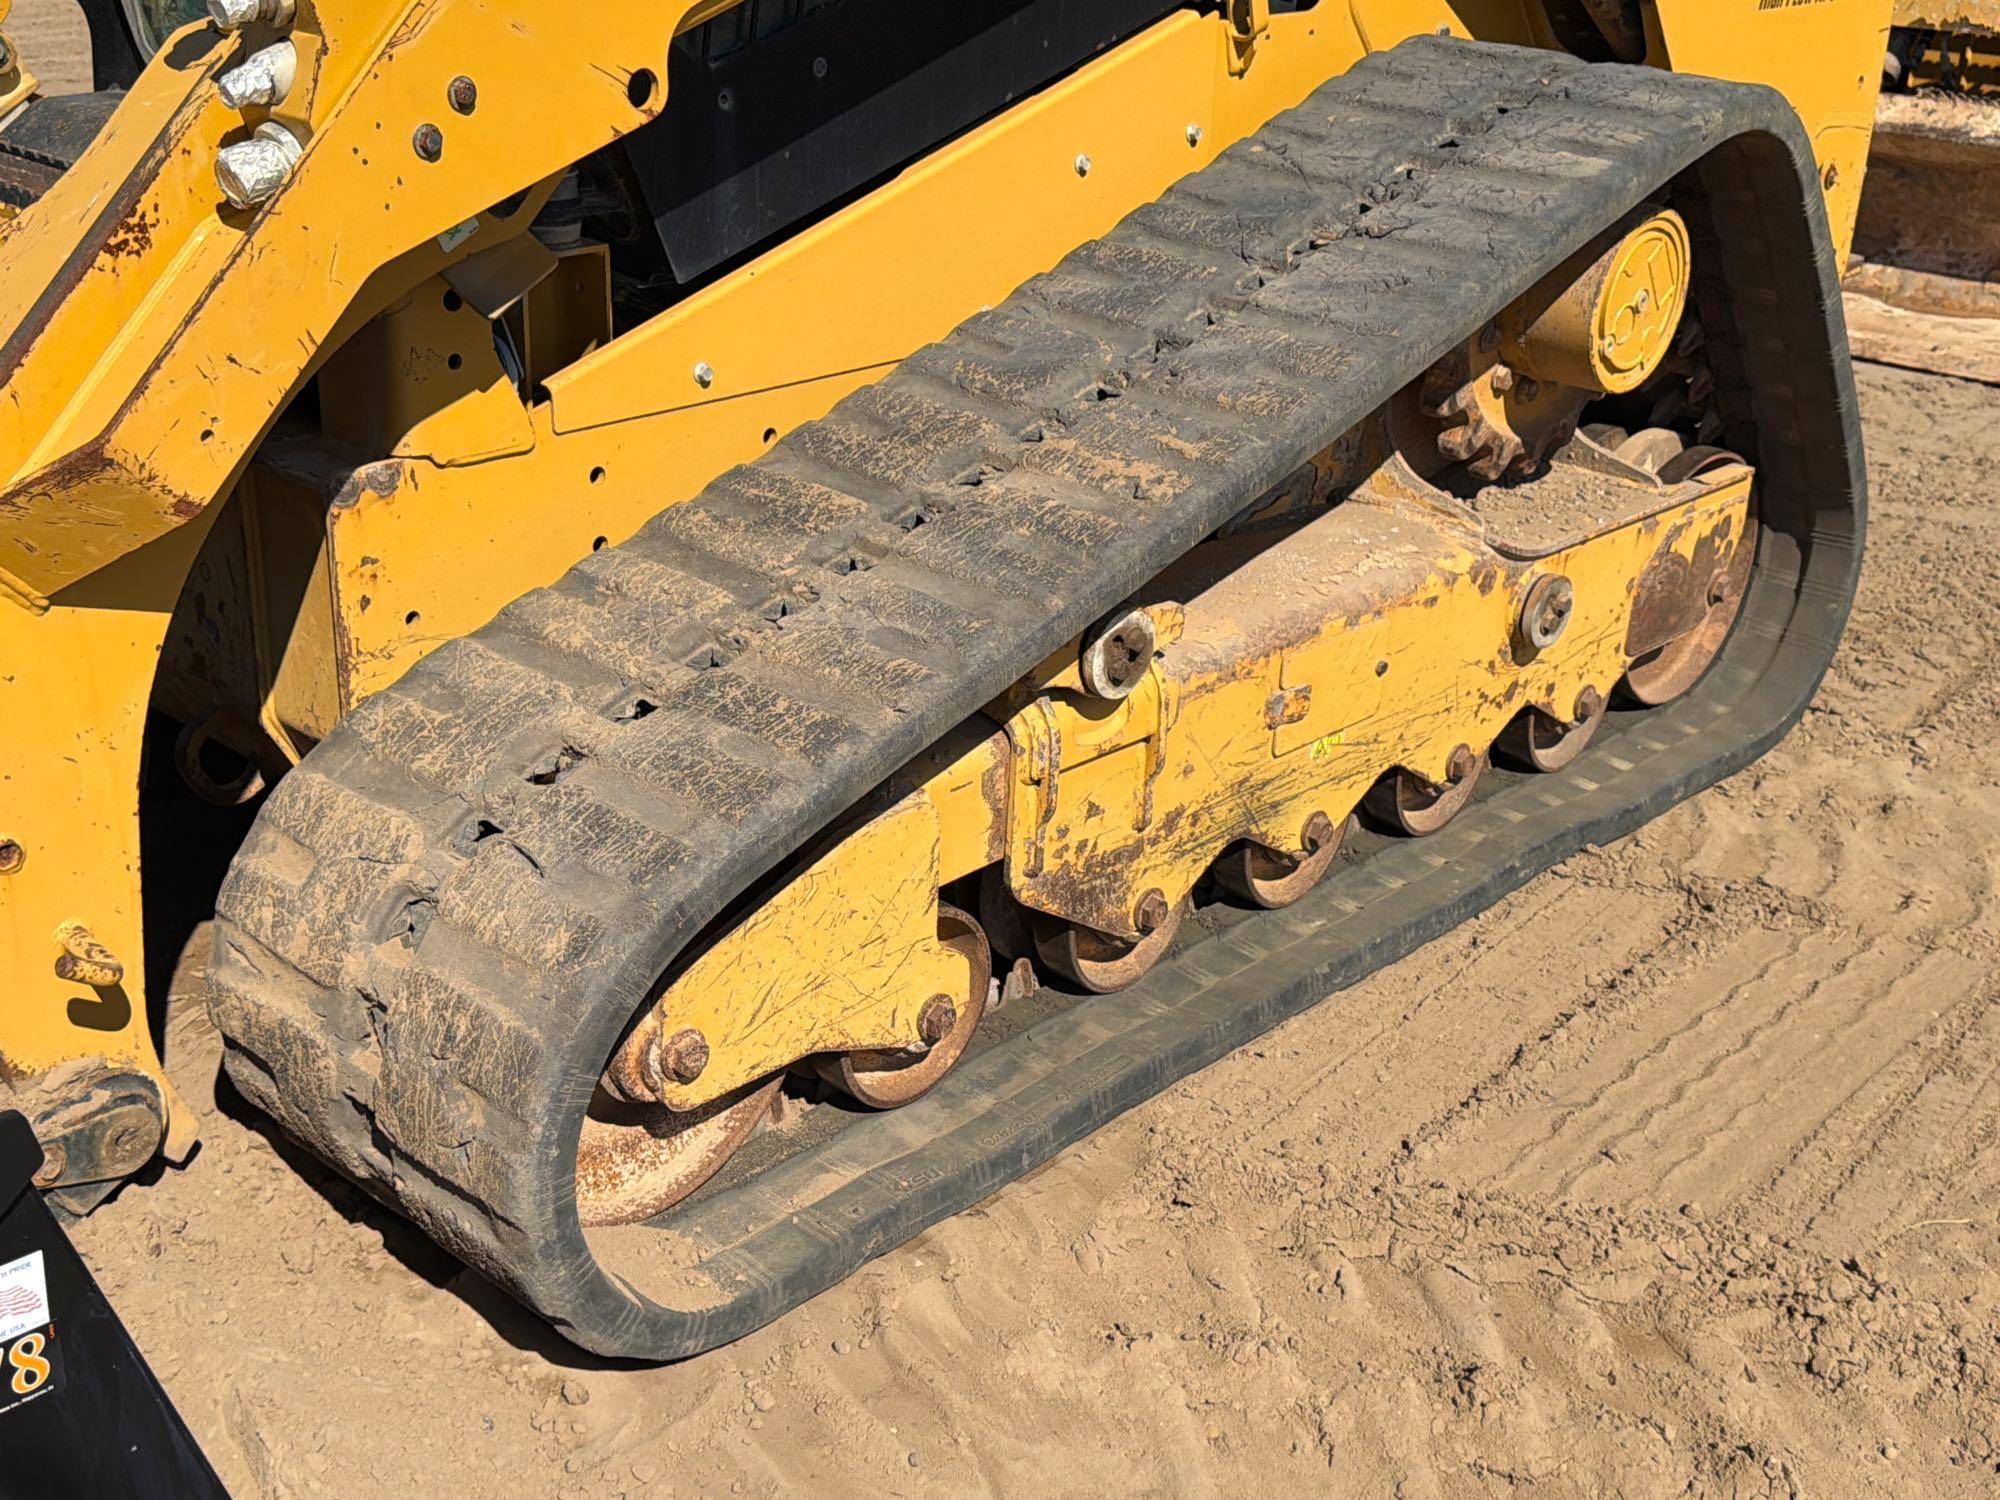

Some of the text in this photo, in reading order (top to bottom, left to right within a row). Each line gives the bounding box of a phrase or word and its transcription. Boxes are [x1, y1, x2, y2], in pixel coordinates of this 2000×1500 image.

[9, 1260, 32, 1275] PRIDE
[9, 1322, 26, 1334] USA
[0, 1332, 50, 1394] 8
